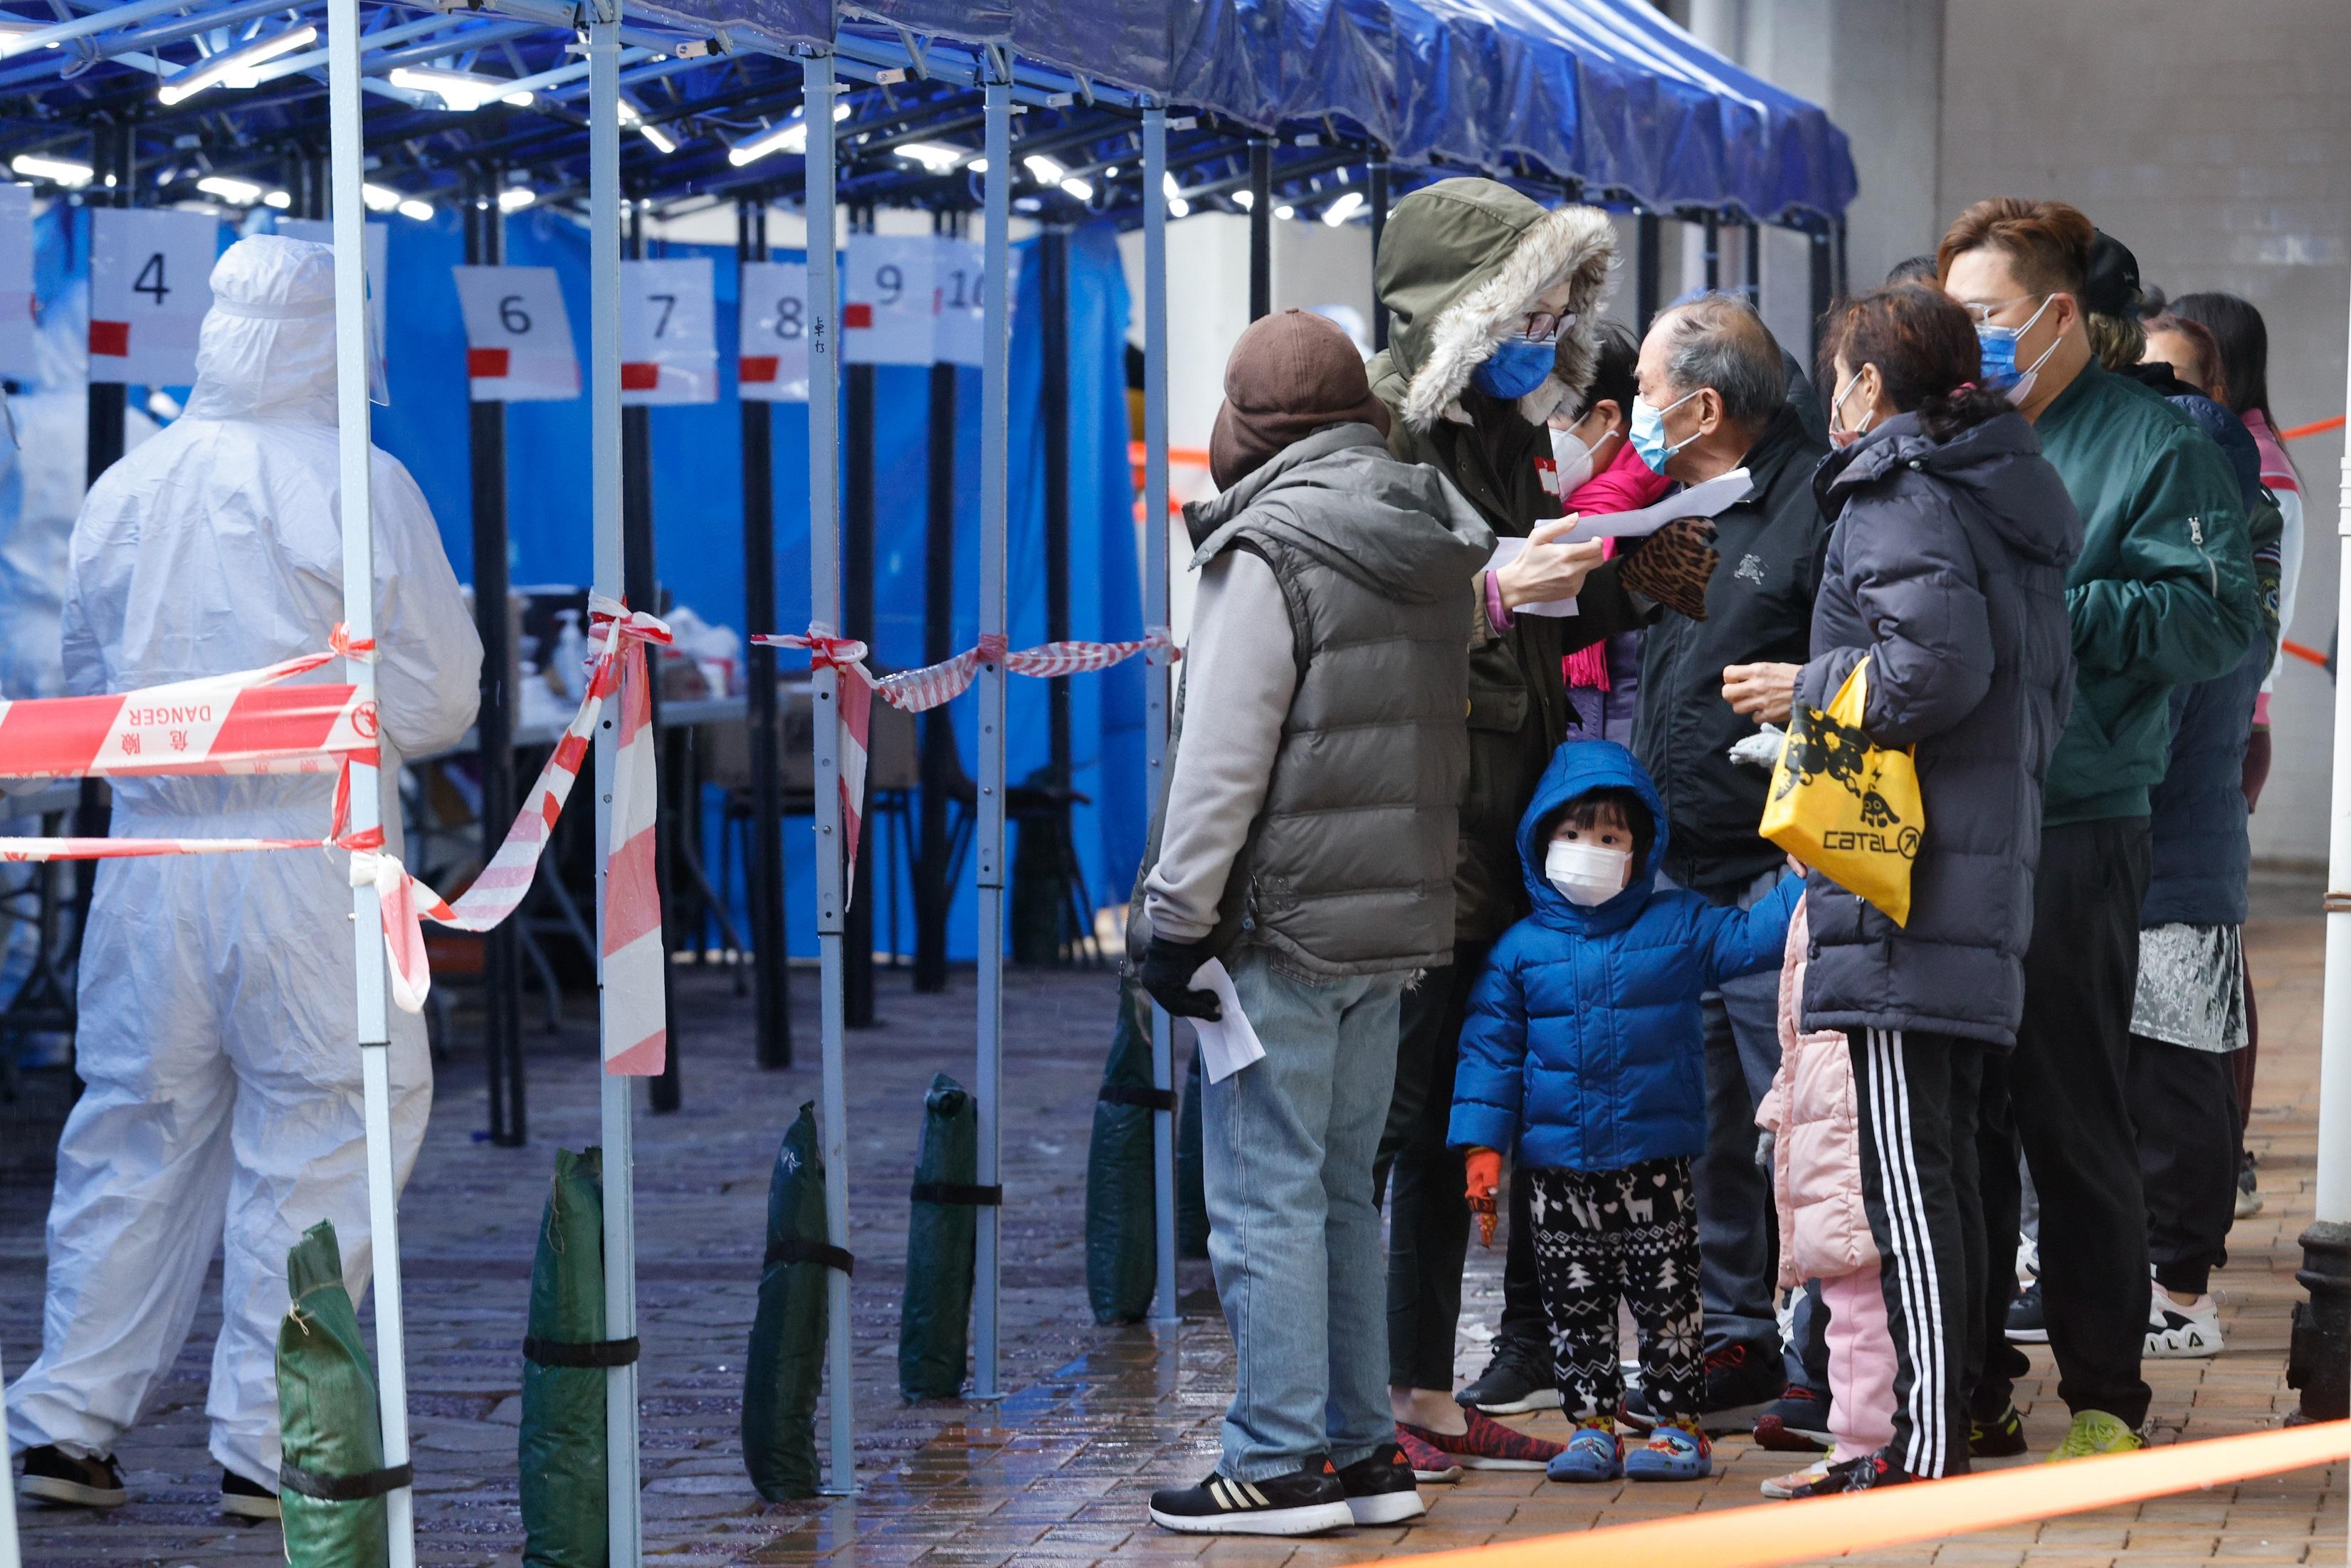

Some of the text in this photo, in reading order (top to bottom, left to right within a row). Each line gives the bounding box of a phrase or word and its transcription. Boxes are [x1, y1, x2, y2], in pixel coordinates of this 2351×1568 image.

[133, 253, 172, 306] 4
[875, 264, 903, 306] 9
[500, 295, 531, 335] 6
[648, 295, 676, 338] 7
[775, 296, 802, 340] 8
[129, 705, 211, 726] DANGER
